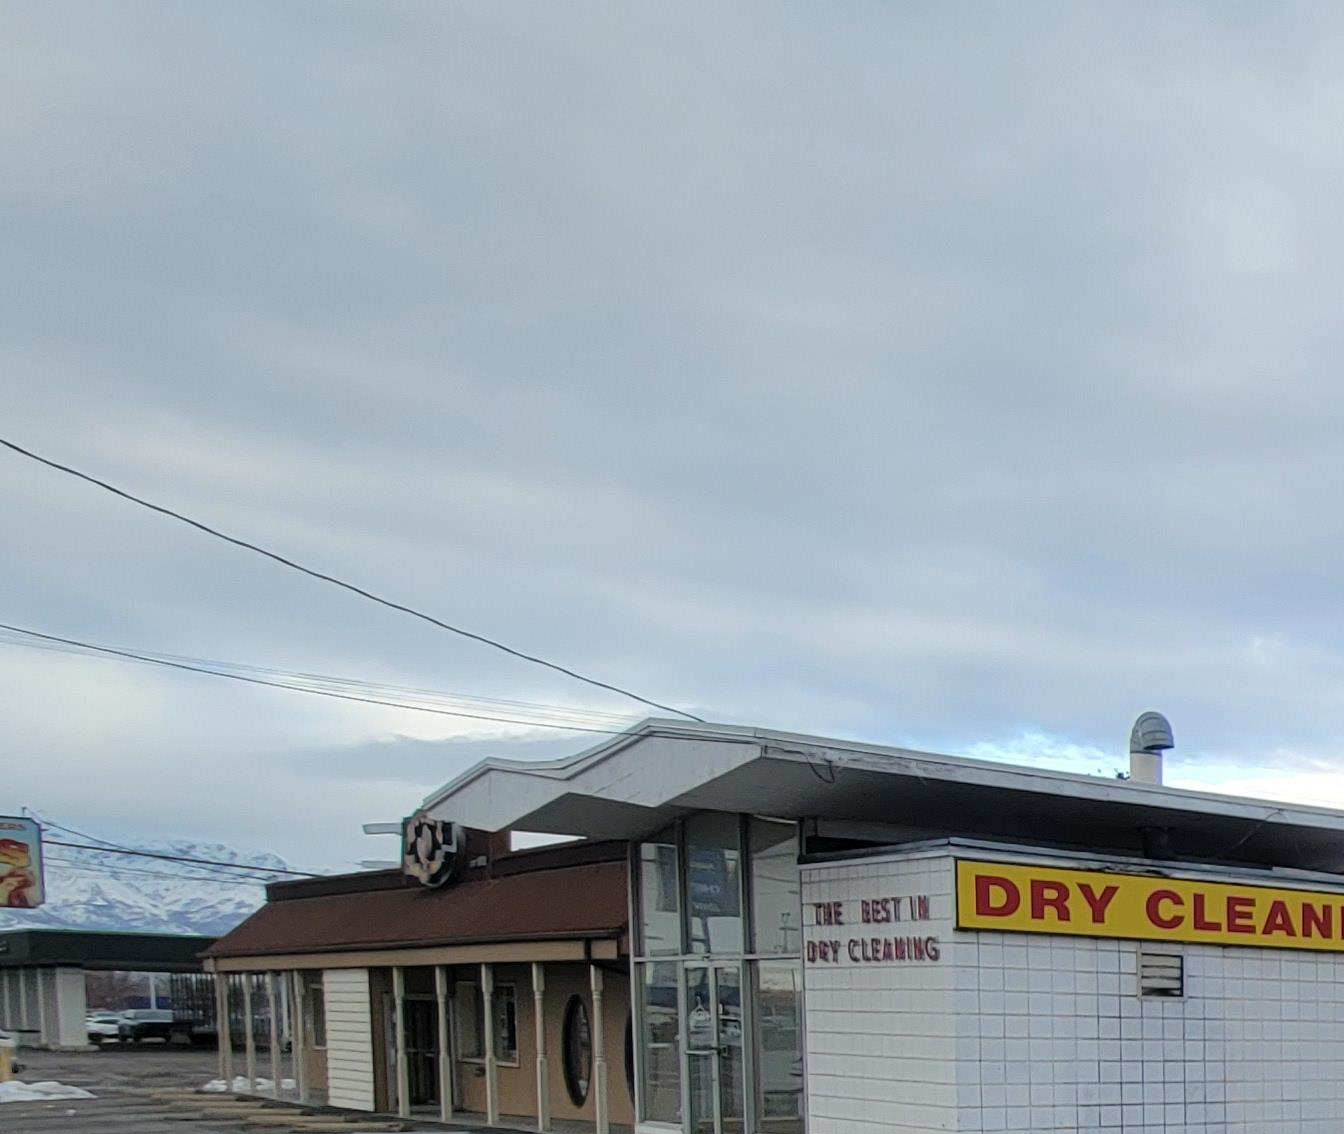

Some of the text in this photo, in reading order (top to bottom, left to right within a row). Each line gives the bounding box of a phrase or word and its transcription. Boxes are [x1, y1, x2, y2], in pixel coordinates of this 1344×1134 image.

[814, 894, 930, 926] THE BEST IN
[974, 874, 1120, 924] DRY
[807, 935, 940, 964] DRY CLEANING
